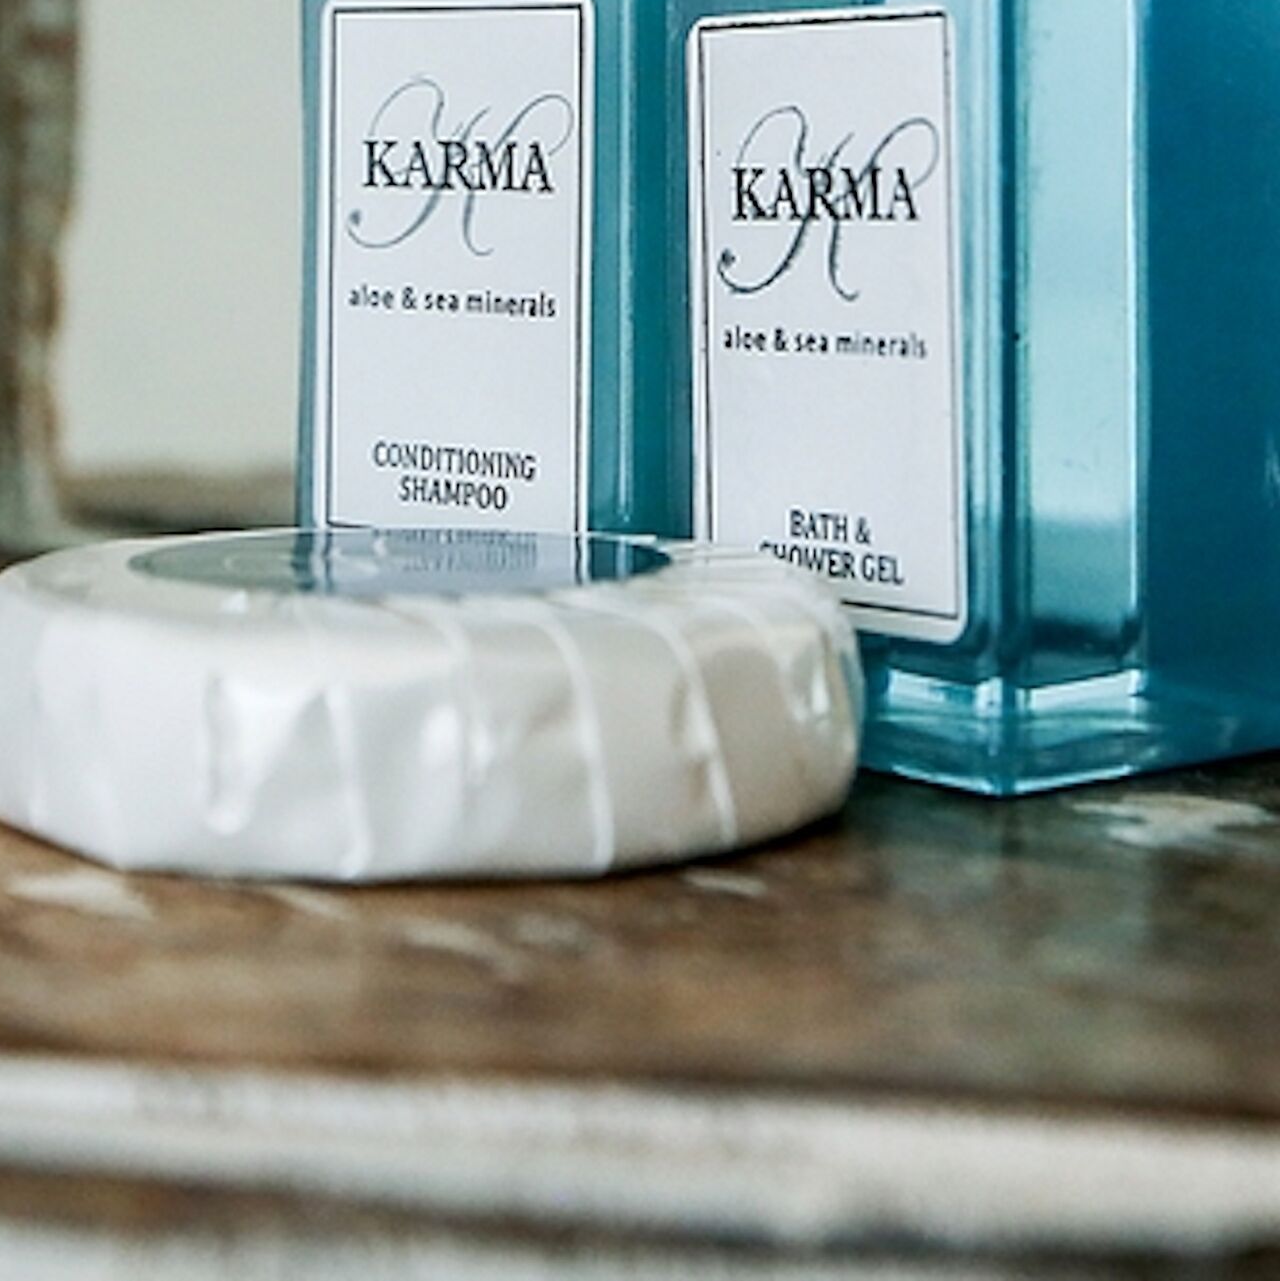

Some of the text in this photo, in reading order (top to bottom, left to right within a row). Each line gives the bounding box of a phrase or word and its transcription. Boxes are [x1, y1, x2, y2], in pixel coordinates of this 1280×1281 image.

[363, 140, 554, 193] KARMA
[732, 167, 918, 221] KARMA
[348, 284, 556, 318] aloe & sea minerals
[725, 325, 928, 359] aloe & sea minerals
[374, 441, 536, 482] CONDITIONING
[399, 476, 507, 510] SHAMPOO
[790, 509, 871, 545] BATH &
[862, 553, 905, 585] GEL
